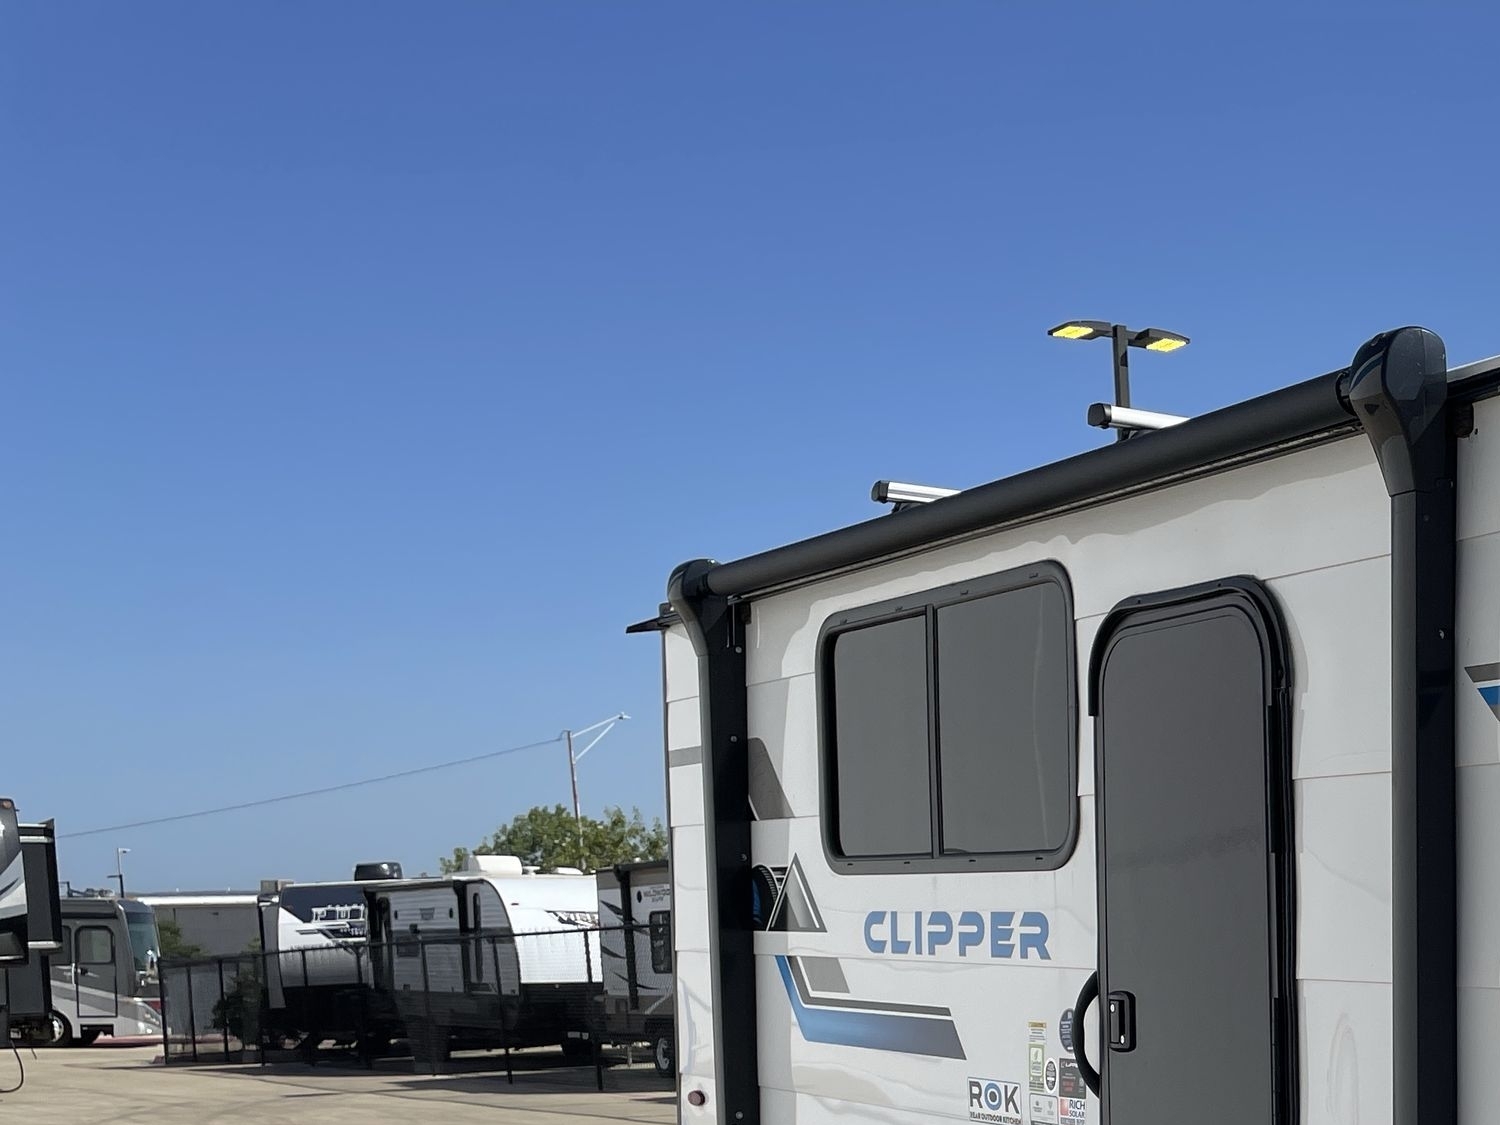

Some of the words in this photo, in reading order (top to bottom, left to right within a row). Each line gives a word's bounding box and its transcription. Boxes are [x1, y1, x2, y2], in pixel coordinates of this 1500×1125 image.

[863, 910, 1052, 960] CLIPPER
[969, 1080, 1020, 1115] ROK
[1069, 1099, 1086, 1110] RICH
